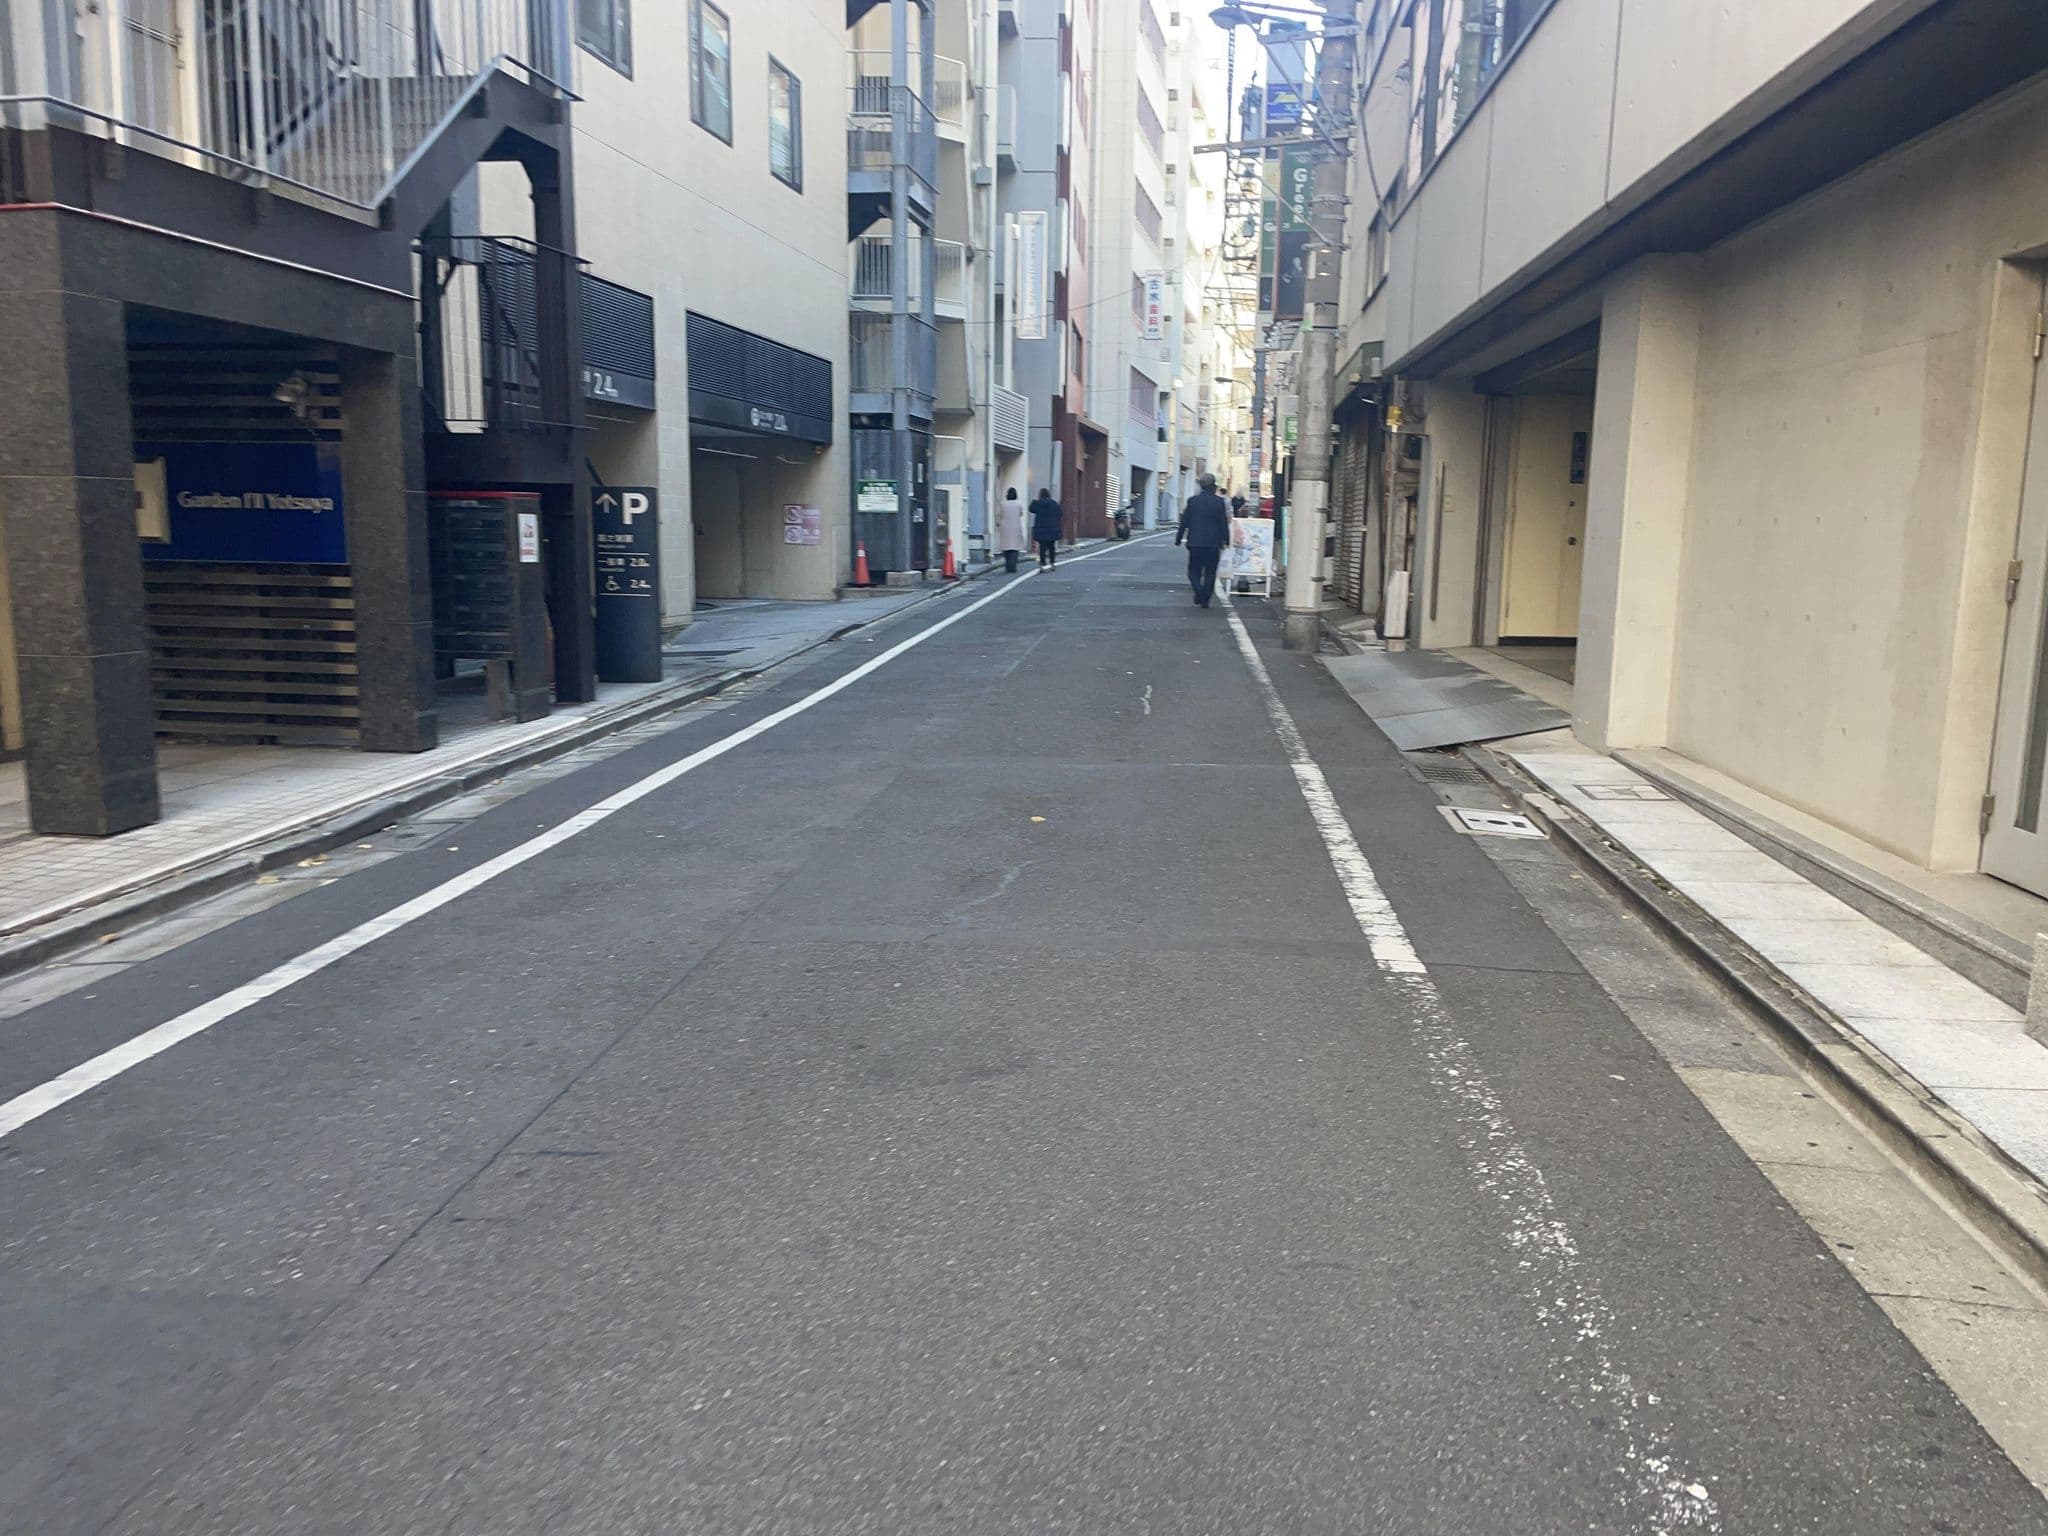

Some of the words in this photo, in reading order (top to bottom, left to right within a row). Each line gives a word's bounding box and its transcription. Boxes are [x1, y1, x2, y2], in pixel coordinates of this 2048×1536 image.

[177, 491, 242, 508] Garden
[265, 494, 334, 514] Yotsuya
[622, 492, 650, 525] P
